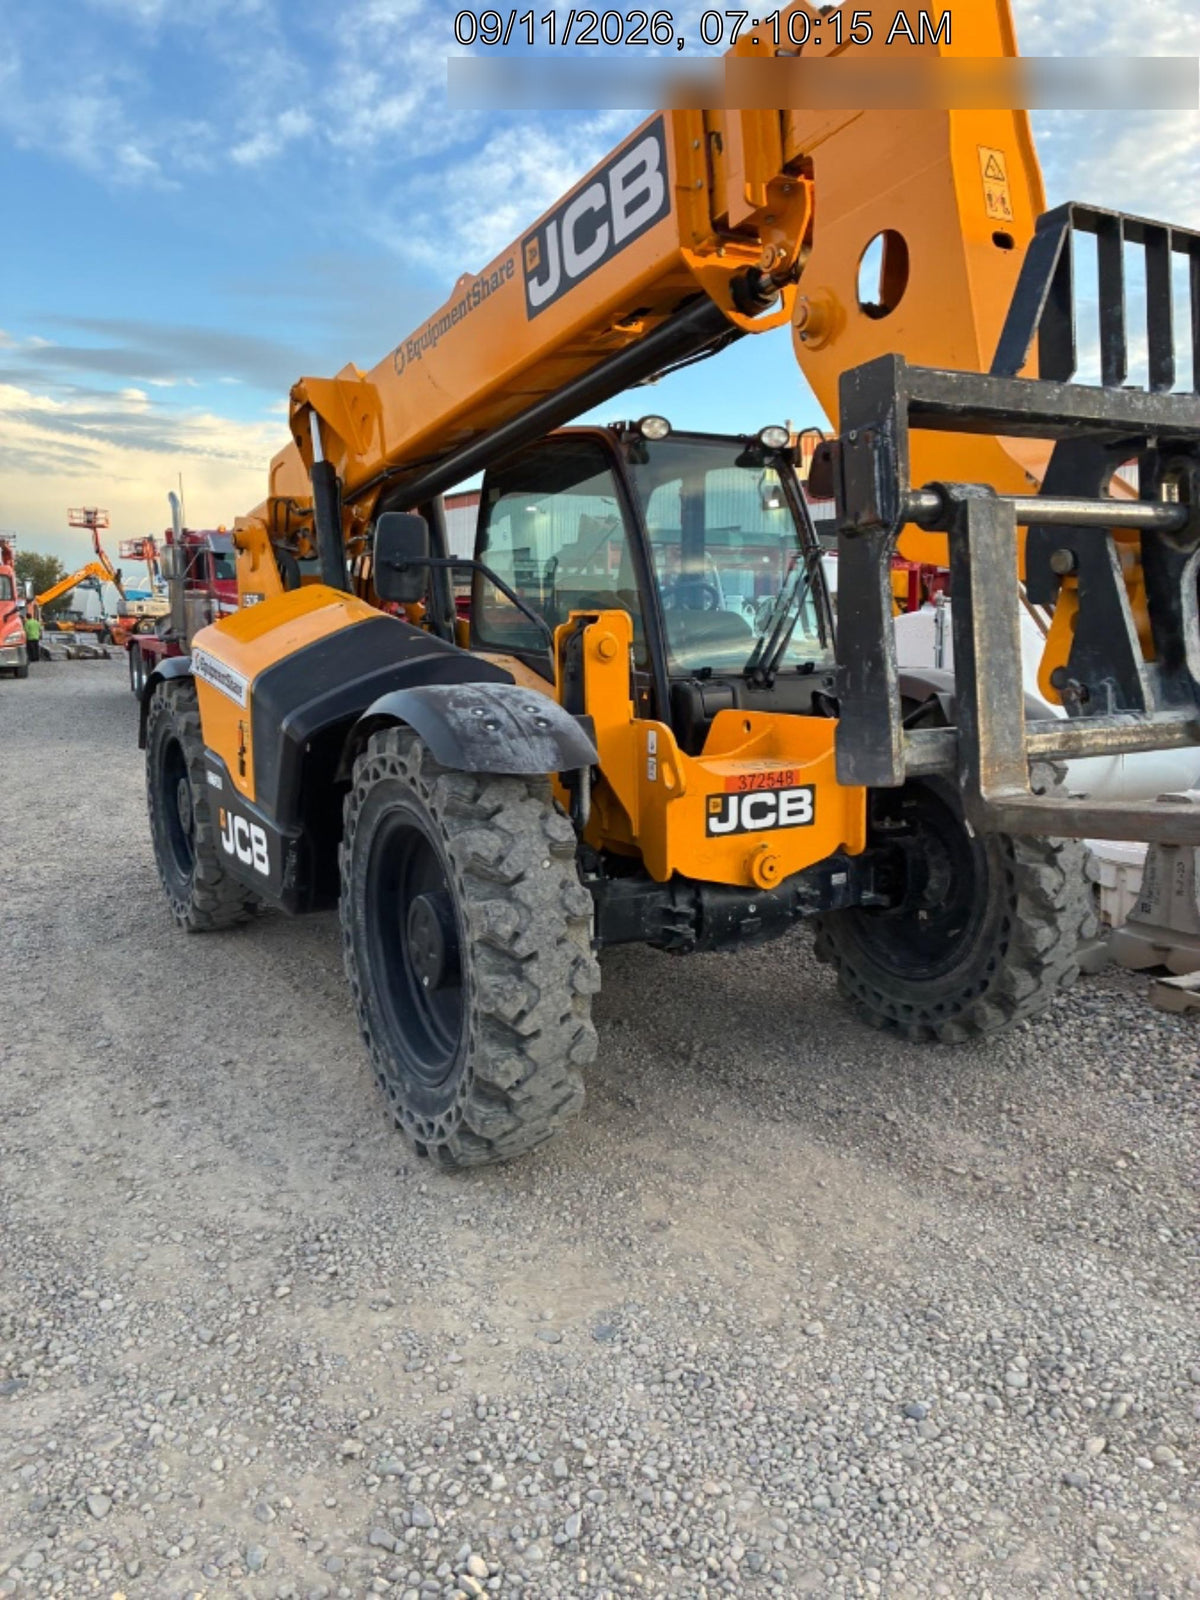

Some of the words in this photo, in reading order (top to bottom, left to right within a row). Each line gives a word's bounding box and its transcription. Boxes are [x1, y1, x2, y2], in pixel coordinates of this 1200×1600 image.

[528, 136, 664, 307] JCB
[406, 257, 515, 363] EquipmentShare
[709, 788, 814, 834] JCB
[738, 770, 794, 790] 372548
[221, 811, 271, 876] JCB
